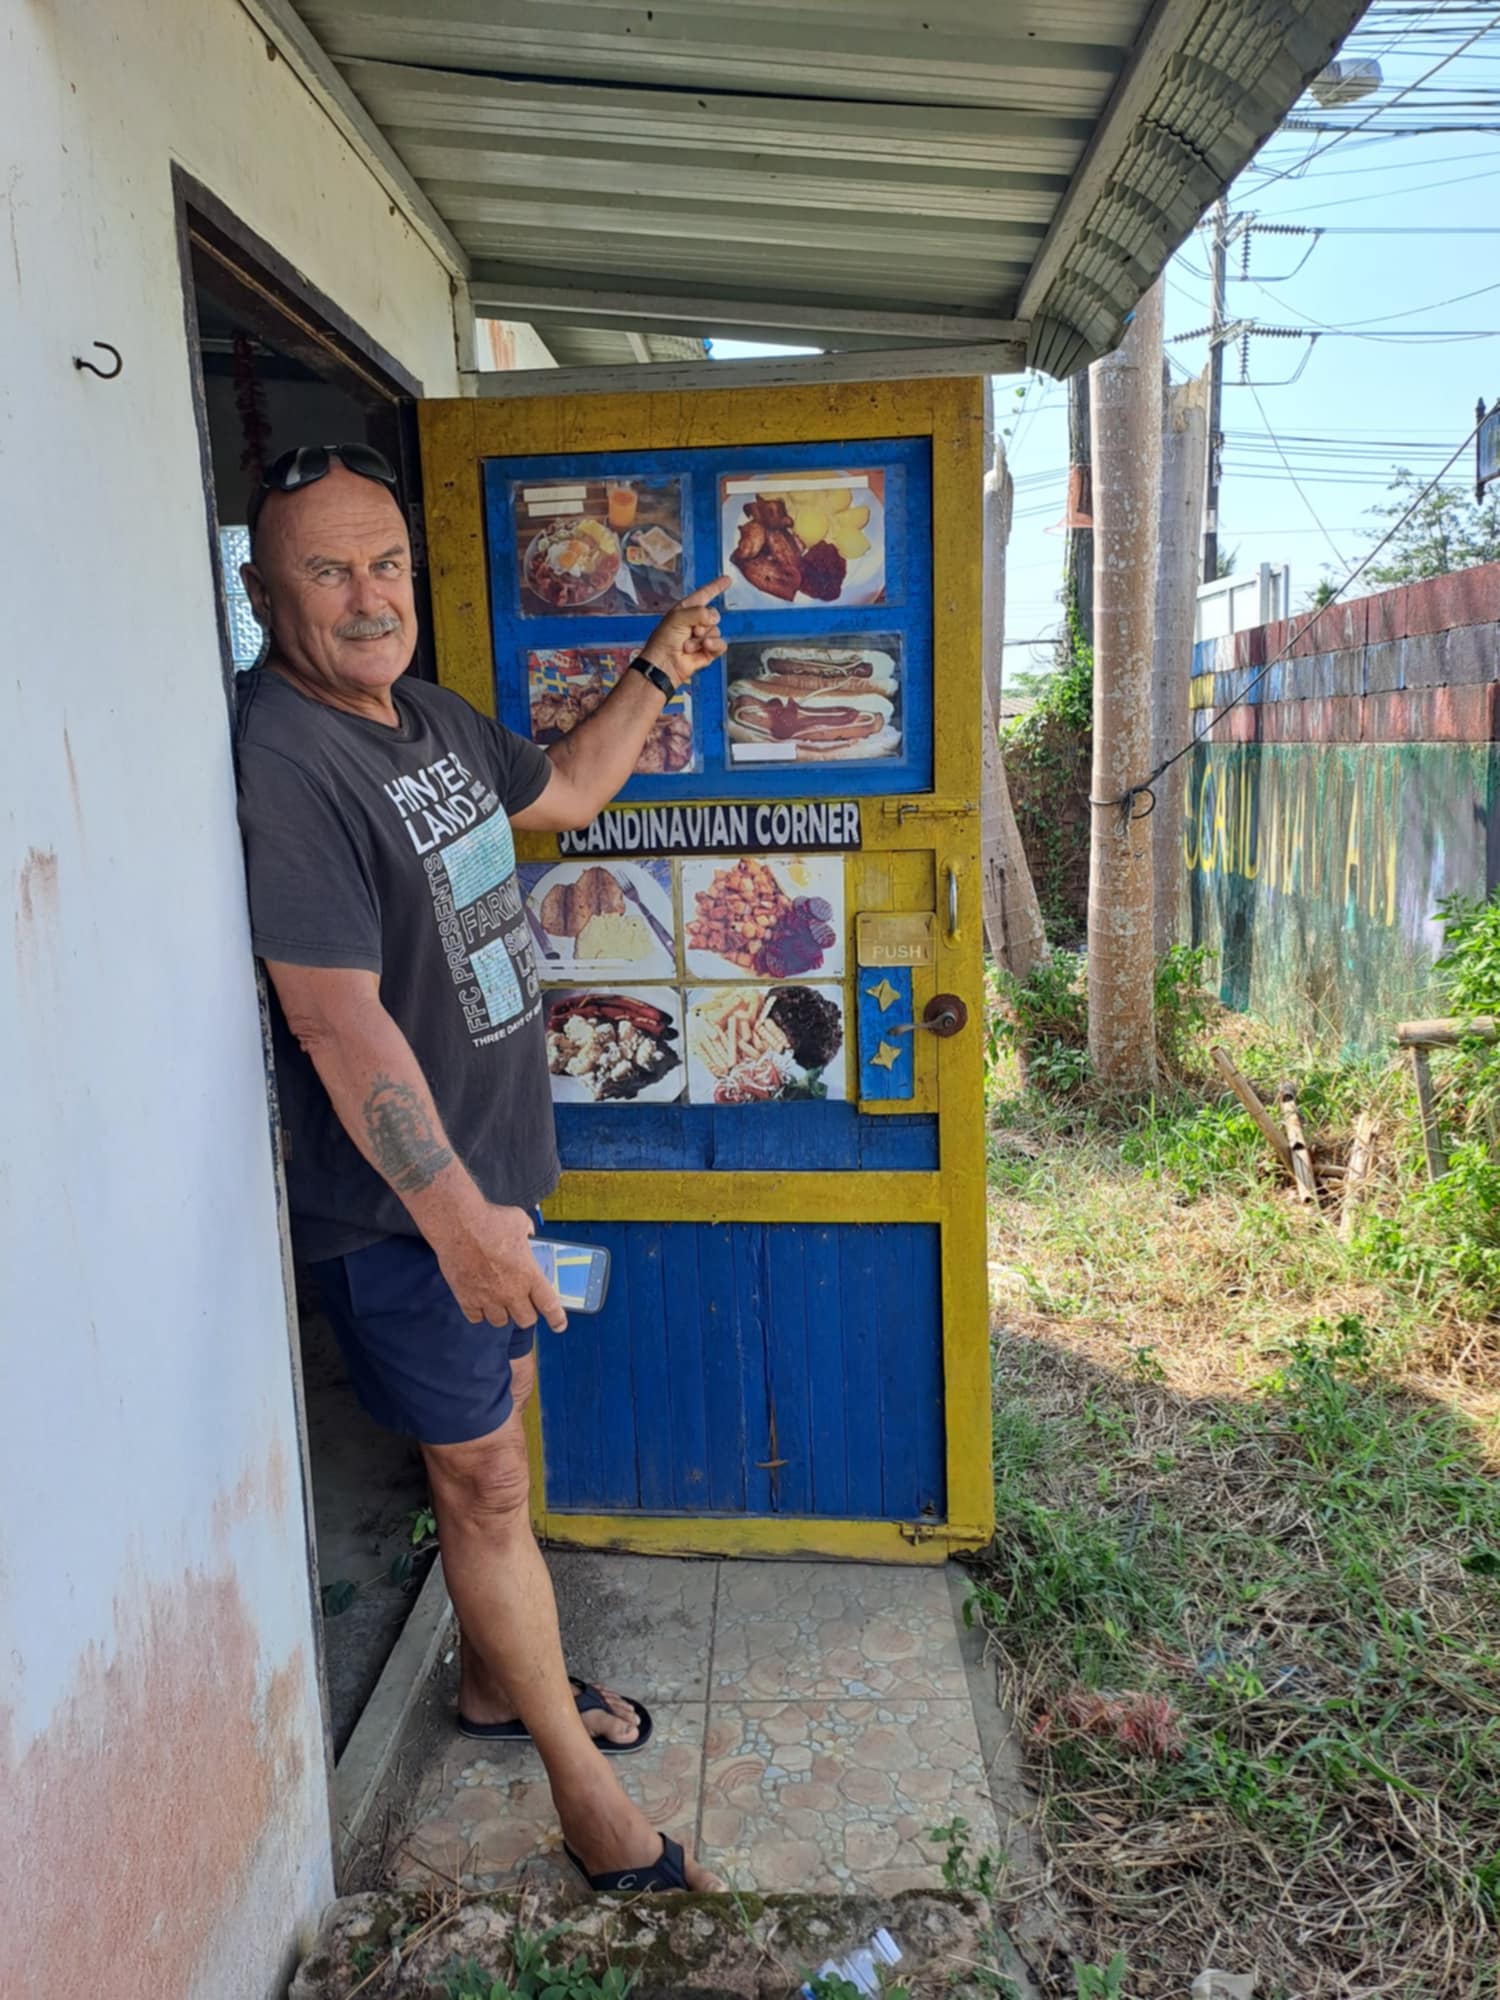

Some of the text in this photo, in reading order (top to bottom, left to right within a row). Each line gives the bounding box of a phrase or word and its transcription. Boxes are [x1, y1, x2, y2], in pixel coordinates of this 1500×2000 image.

[404, 794, 477, 856] LAND
[755, 802, 860, 846] CORNER
[424, 852, 490, 1034] FFC PRESENTS
[872, 944, 921, 960] PUSH
[472, 1029, 507, 1048] THREE
